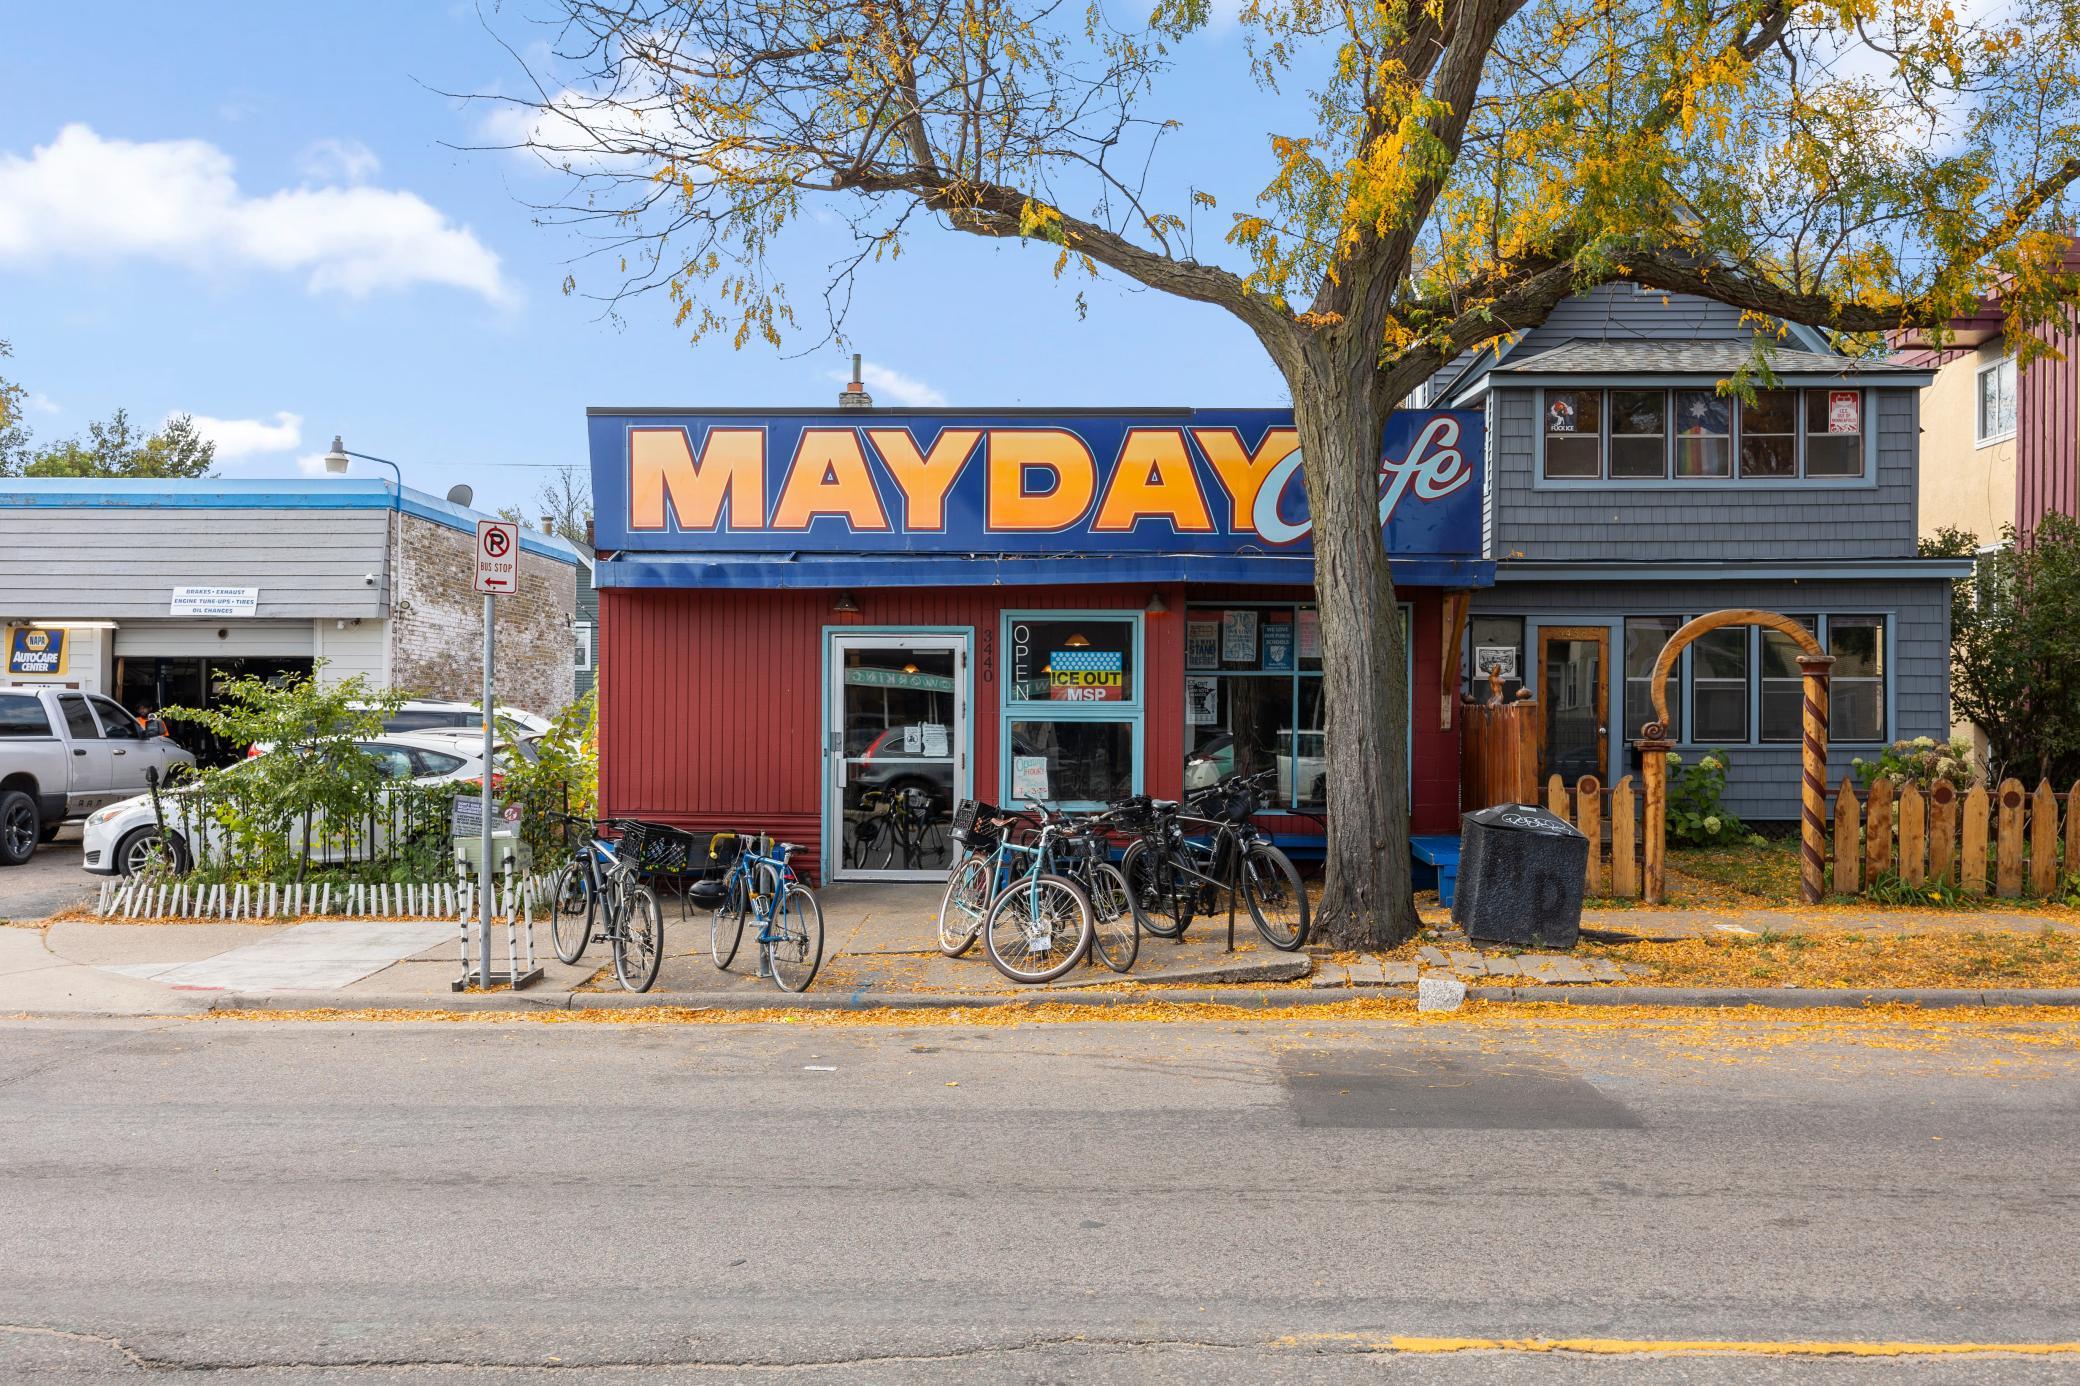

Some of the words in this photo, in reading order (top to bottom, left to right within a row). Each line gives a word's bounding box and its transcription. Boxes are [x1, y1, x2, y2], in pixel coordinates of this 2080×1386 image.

[626, 425, 1301, 535] MAYDAY
[1252, 415, 1473, 547] Cfe
[480, 562, 492, 572] BUS
[494, 564, 512, 572] STOP
[29, 636, 45, 645] NAPA
[984, 629, 992, 682] 3440
[22, 662, 49, 672] CENTER
[1014, 625, 1030, 700] OPEN
[1052, 672, 1079, 685] ICE
[1084, 672, 1120, 685] OUT
[1067, 688, 1106, 701] MSP
